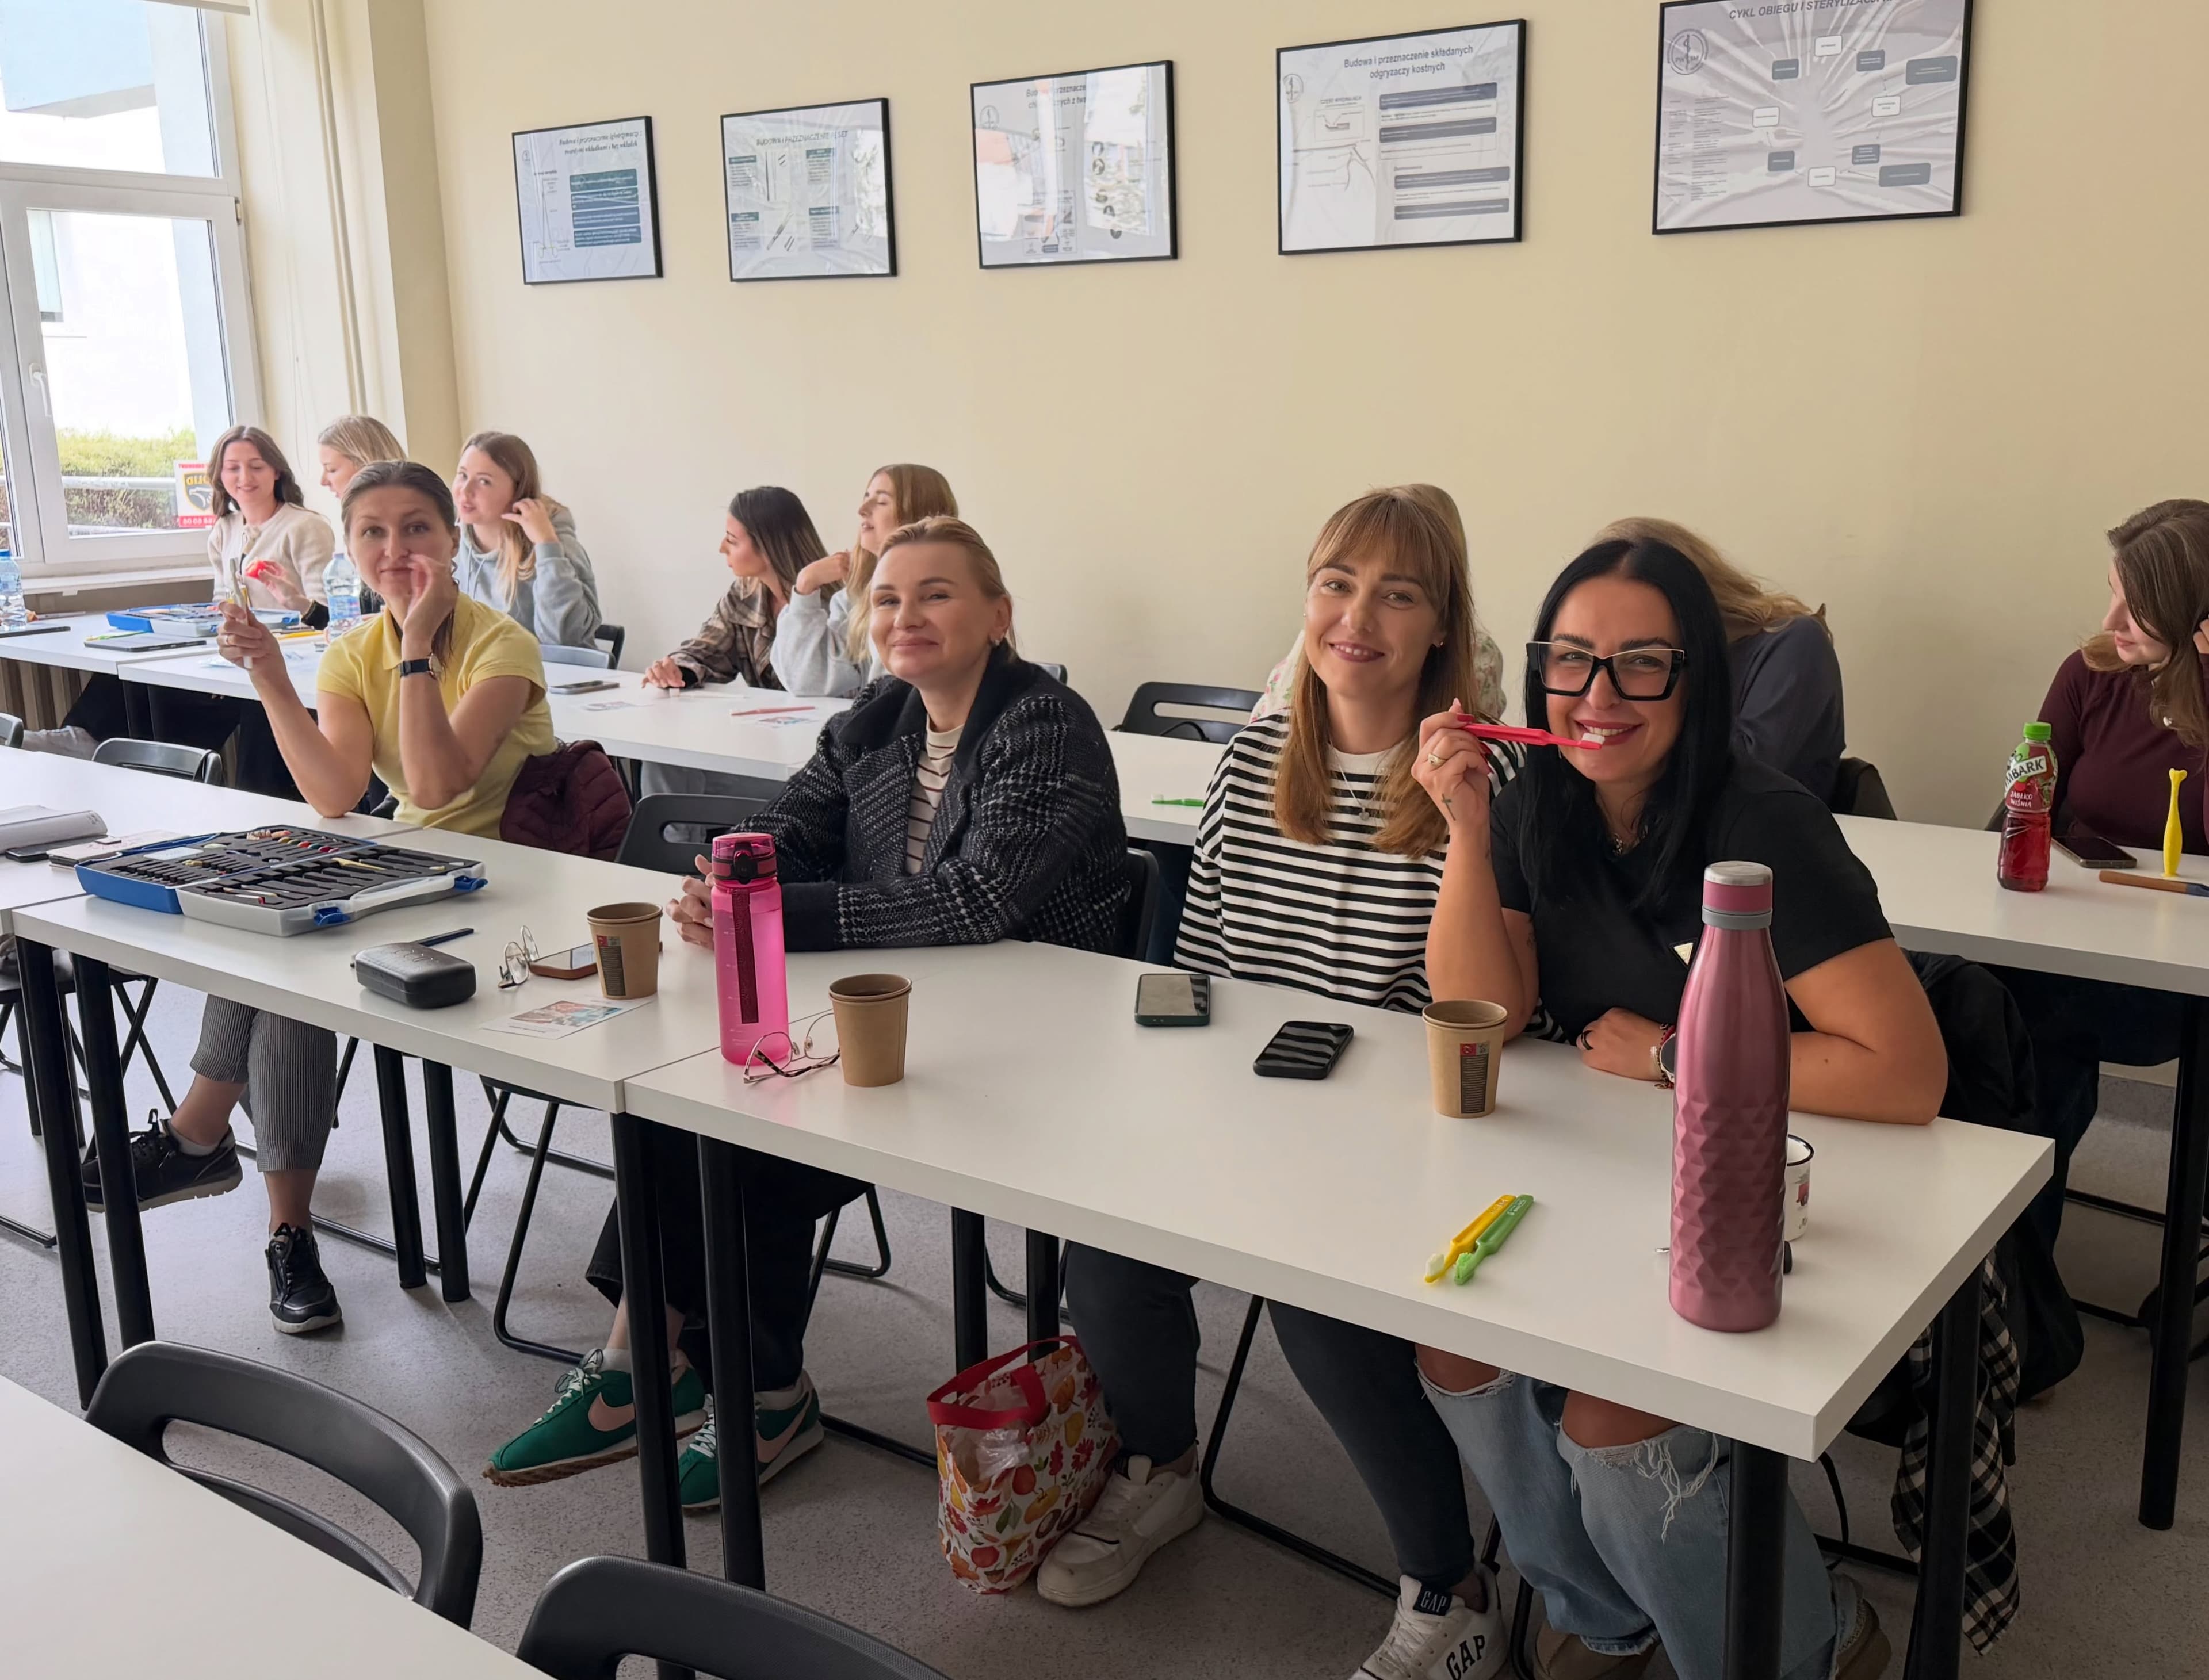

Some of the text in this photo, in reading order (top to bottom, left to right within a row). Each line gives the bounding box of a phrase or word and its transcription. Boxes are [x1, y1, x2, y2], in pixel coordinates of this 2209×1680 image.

[1729, 0, 1880, 20] CYKL OBIEGU I STERYLIZA
[1344, 58, 1373, 68] Budowa
[1378, 49, 1429, 66] przeznaczenie
[1431, 45, 1473, 58] składanych
[1369, 62, 1445, 80] odgryzaczy kostnych
[2005, 759, 2044, 788] MBARK
[2011, 791, 2033, 800] JABŁKO
[2011, 798, 2032, 808] WIŚNIA
[1420, 1591, 1447, 1612] GAP
[1446, 1635, 1485, 1680] GAP
